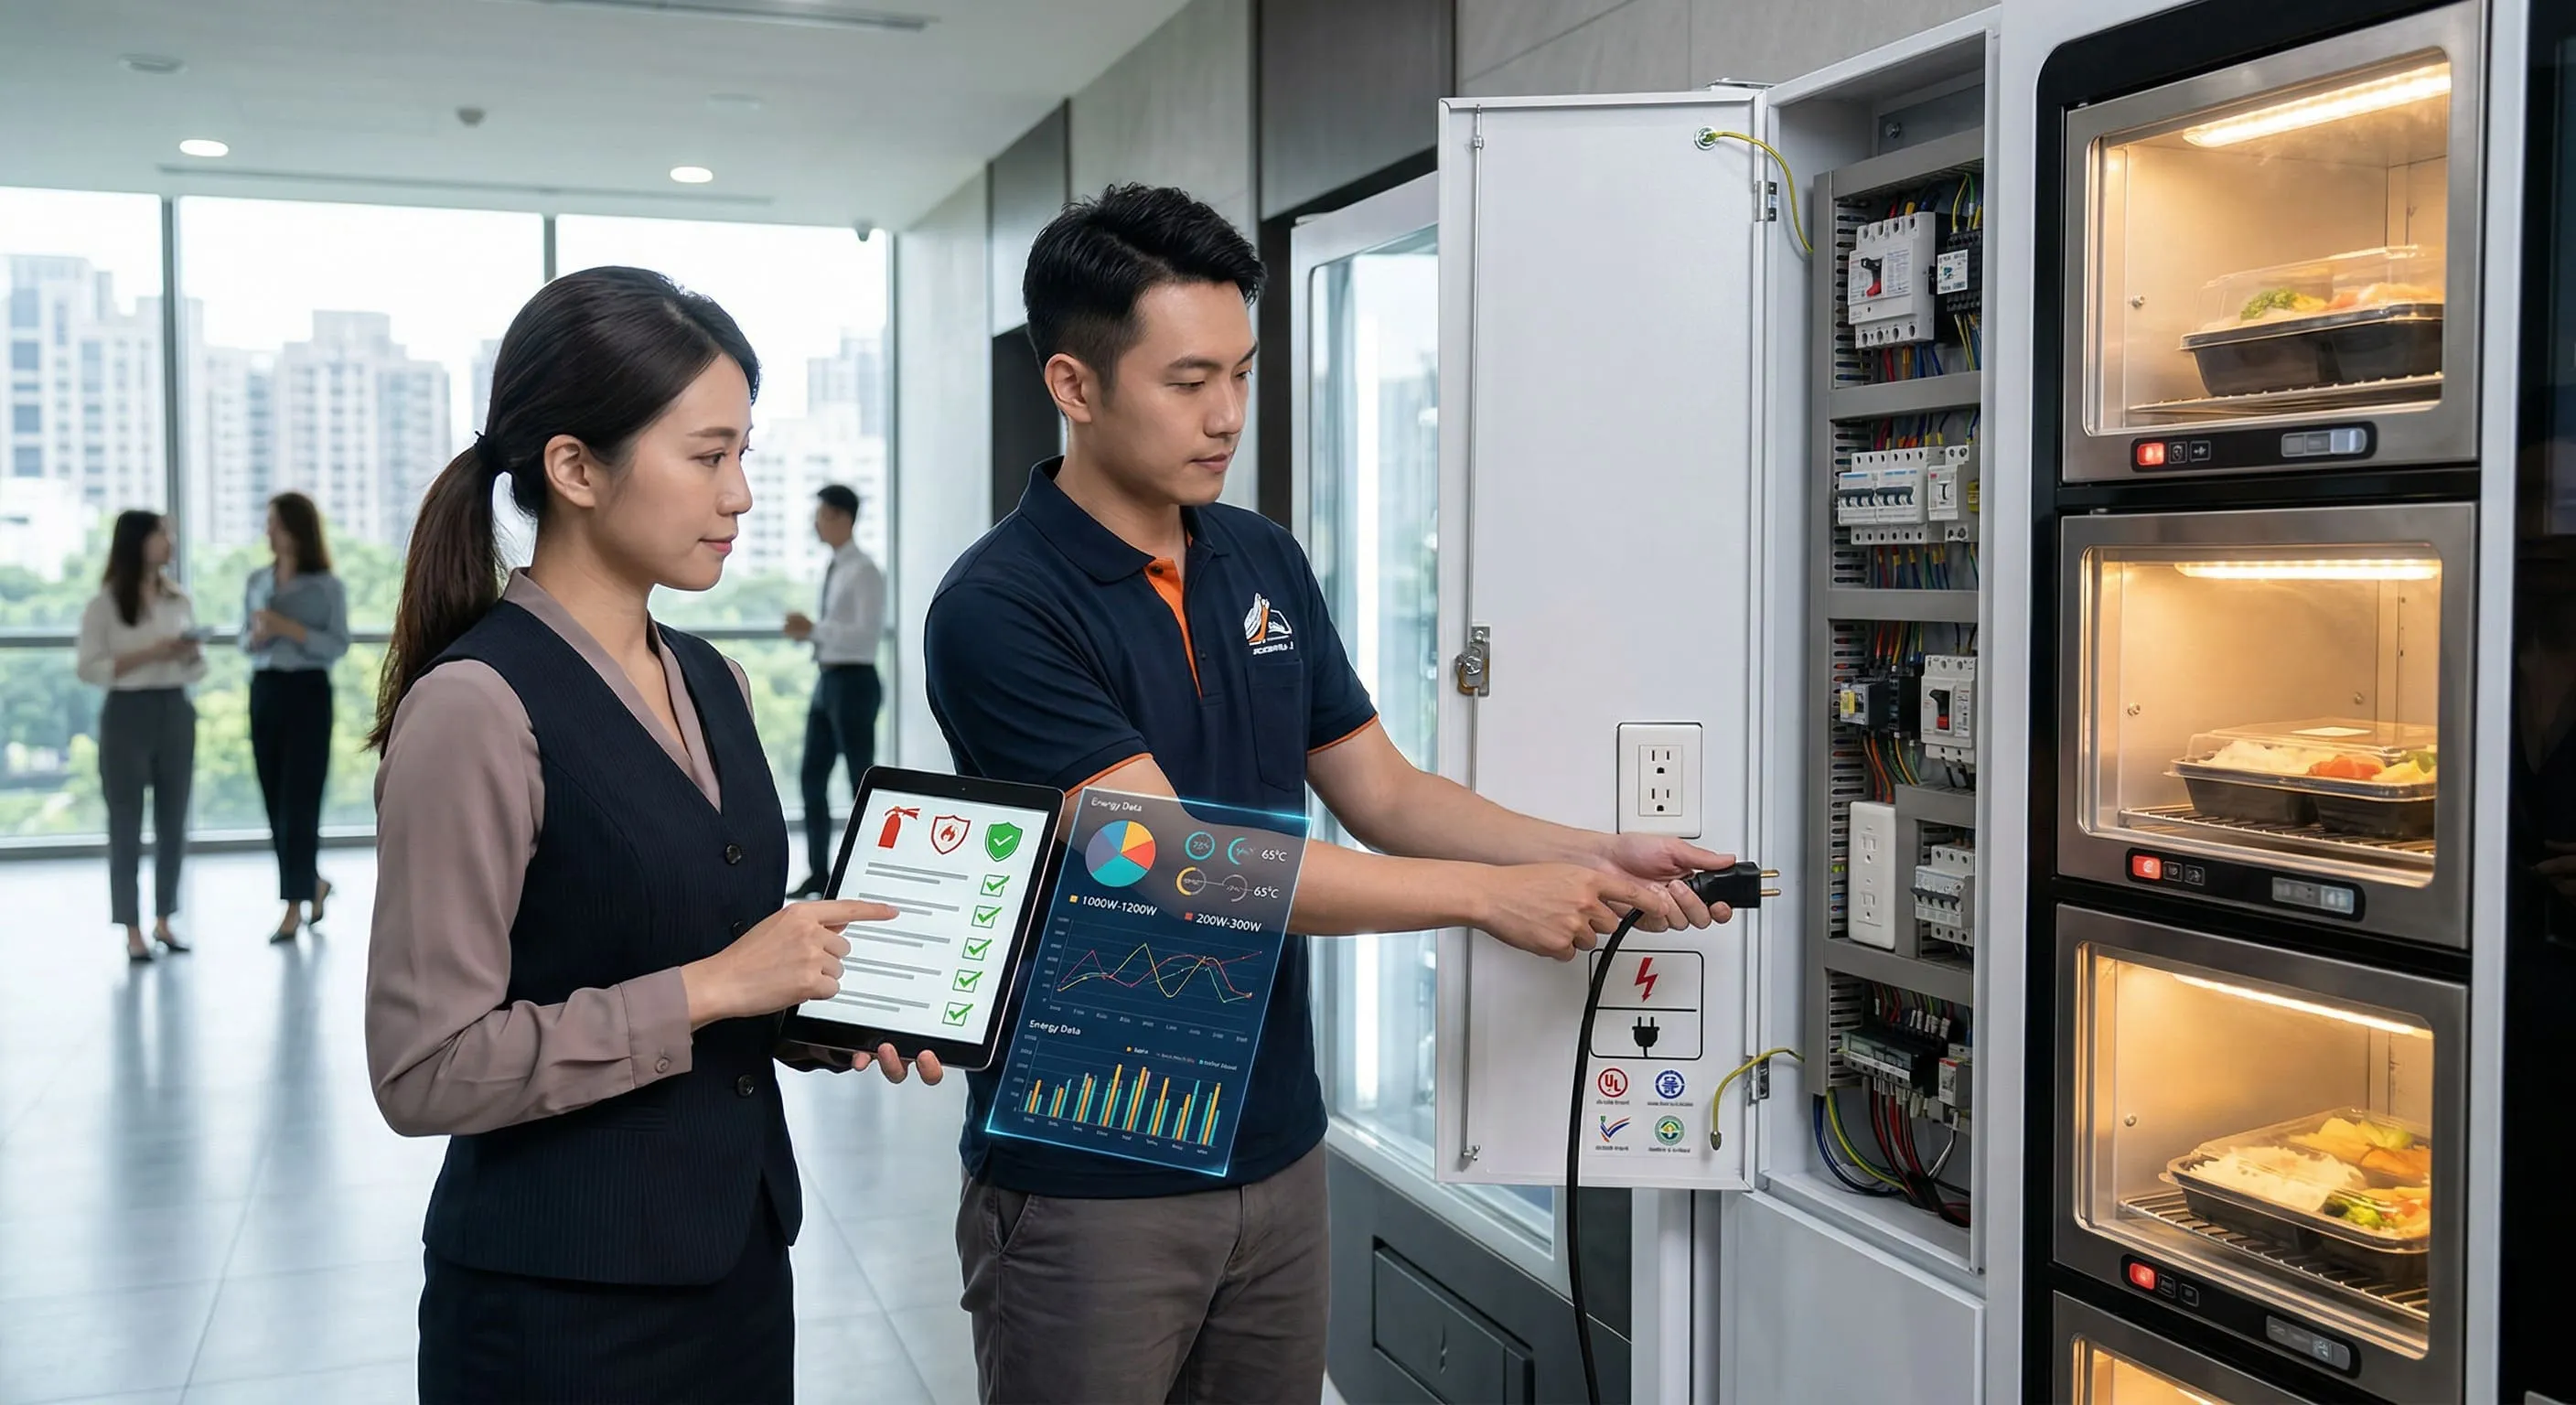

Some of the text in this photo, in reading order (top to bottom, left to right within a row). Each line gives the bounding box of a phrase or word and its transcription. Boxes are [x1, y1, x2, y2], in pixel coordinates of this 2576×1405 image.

[1082, 896, 1158, 916] 1000W-1200W
[1196, 913, 1262, 932] 200W-300W
[1605, 1074, 1622, 1092] UL
